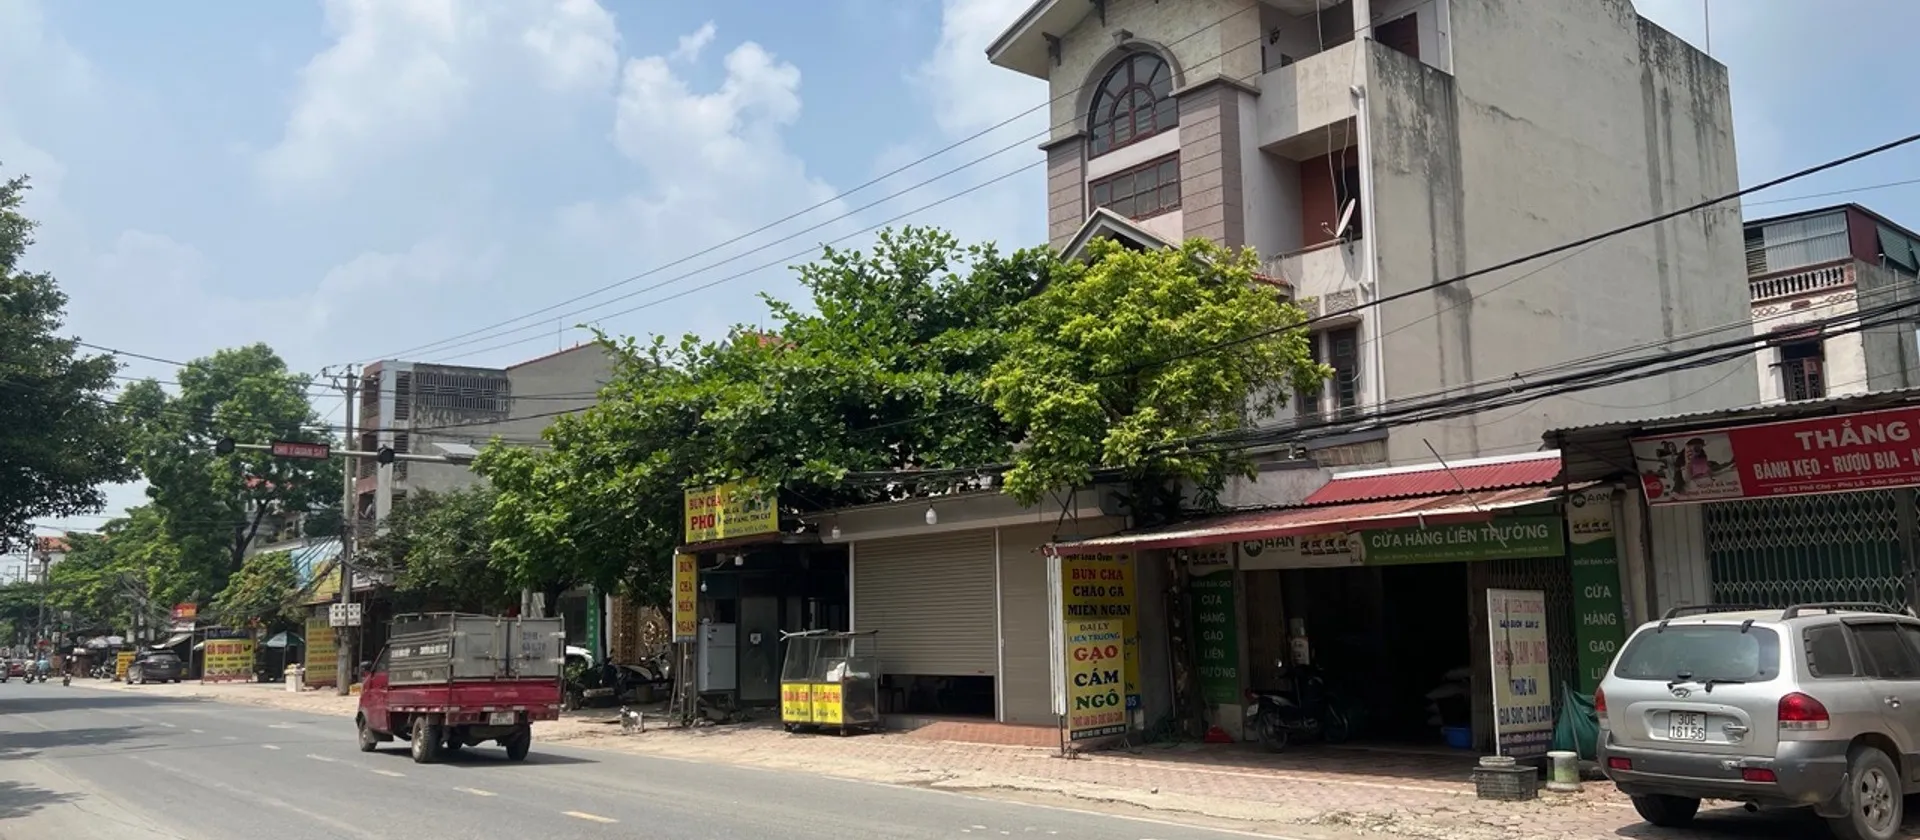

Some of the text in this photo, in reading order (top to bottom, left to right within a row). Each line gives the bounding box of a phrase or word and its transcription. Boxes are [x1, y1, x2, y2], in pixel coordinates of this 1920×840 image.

[1794, 419, 1911, 451] THẮNG
[1753, 459, 1791, 480] BÁNH
[1793, 457, 1821, 480] KẸO
[1832, 451, 1871, 476] RƯỢU
[1873, 450, 1901, 469] BIA
[1372, 522, 1548, 548] CỬA HÀNG LIÊN TRƯỜNG
[1584, 585, 1612, 599] CỬA
[1583, 612, 1617, 626] HÀNG
[1074, 645, 1118, 664] GẠO
[1588, 640, 1615, 655] GẠO
[1074, 668, 1119, 687] CÁM
[1076, 688, 1119, 711] NGÔ
[1678, 713, 1697, 725] 30E
